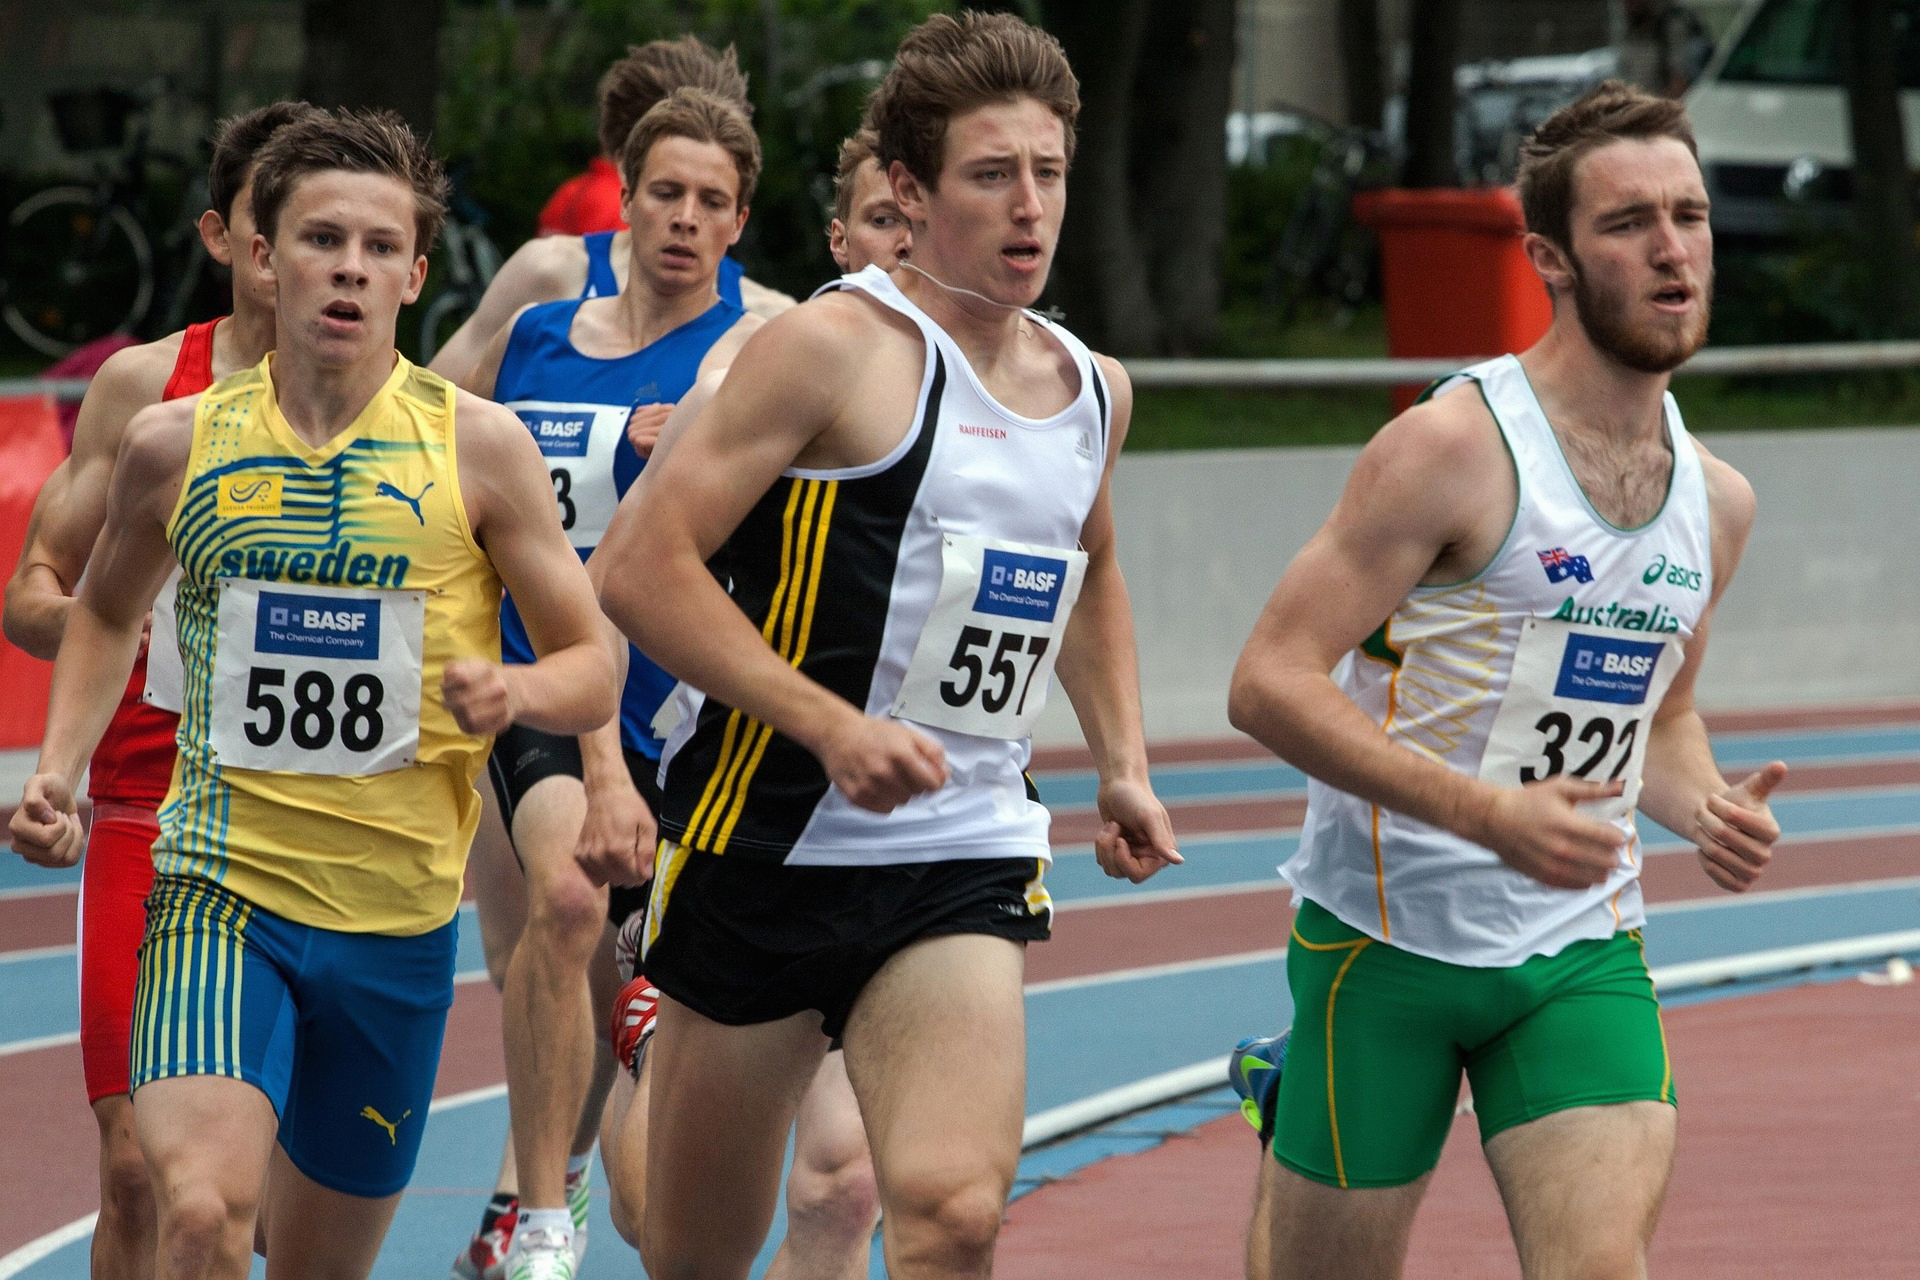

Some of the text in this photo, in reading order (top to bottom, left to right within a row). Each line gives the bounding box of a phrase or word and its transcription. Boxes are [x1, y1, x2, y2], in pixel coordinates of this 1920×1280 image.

[539, 420, 584, 437] BASF
[958, 423, 1007, 439] RAIFFEISEN
[550, 467, 576, 531] 3
[219, 540, 410, 588] sweden
[1666, 564, 1702, 591] asics
[1013, 568, 1057, 593] BASF
[303, 609, 366, 632] BASF
[1551, 596, 1680, 634] Australia
[269, 631, 365, 648] The Chemical Company
[940, 624, 1050, 716] 557
[1602, 652, 1654, 677] BASF
[243, 666, 384, 753] 588
[1520, 711, 1641, 788] 322
